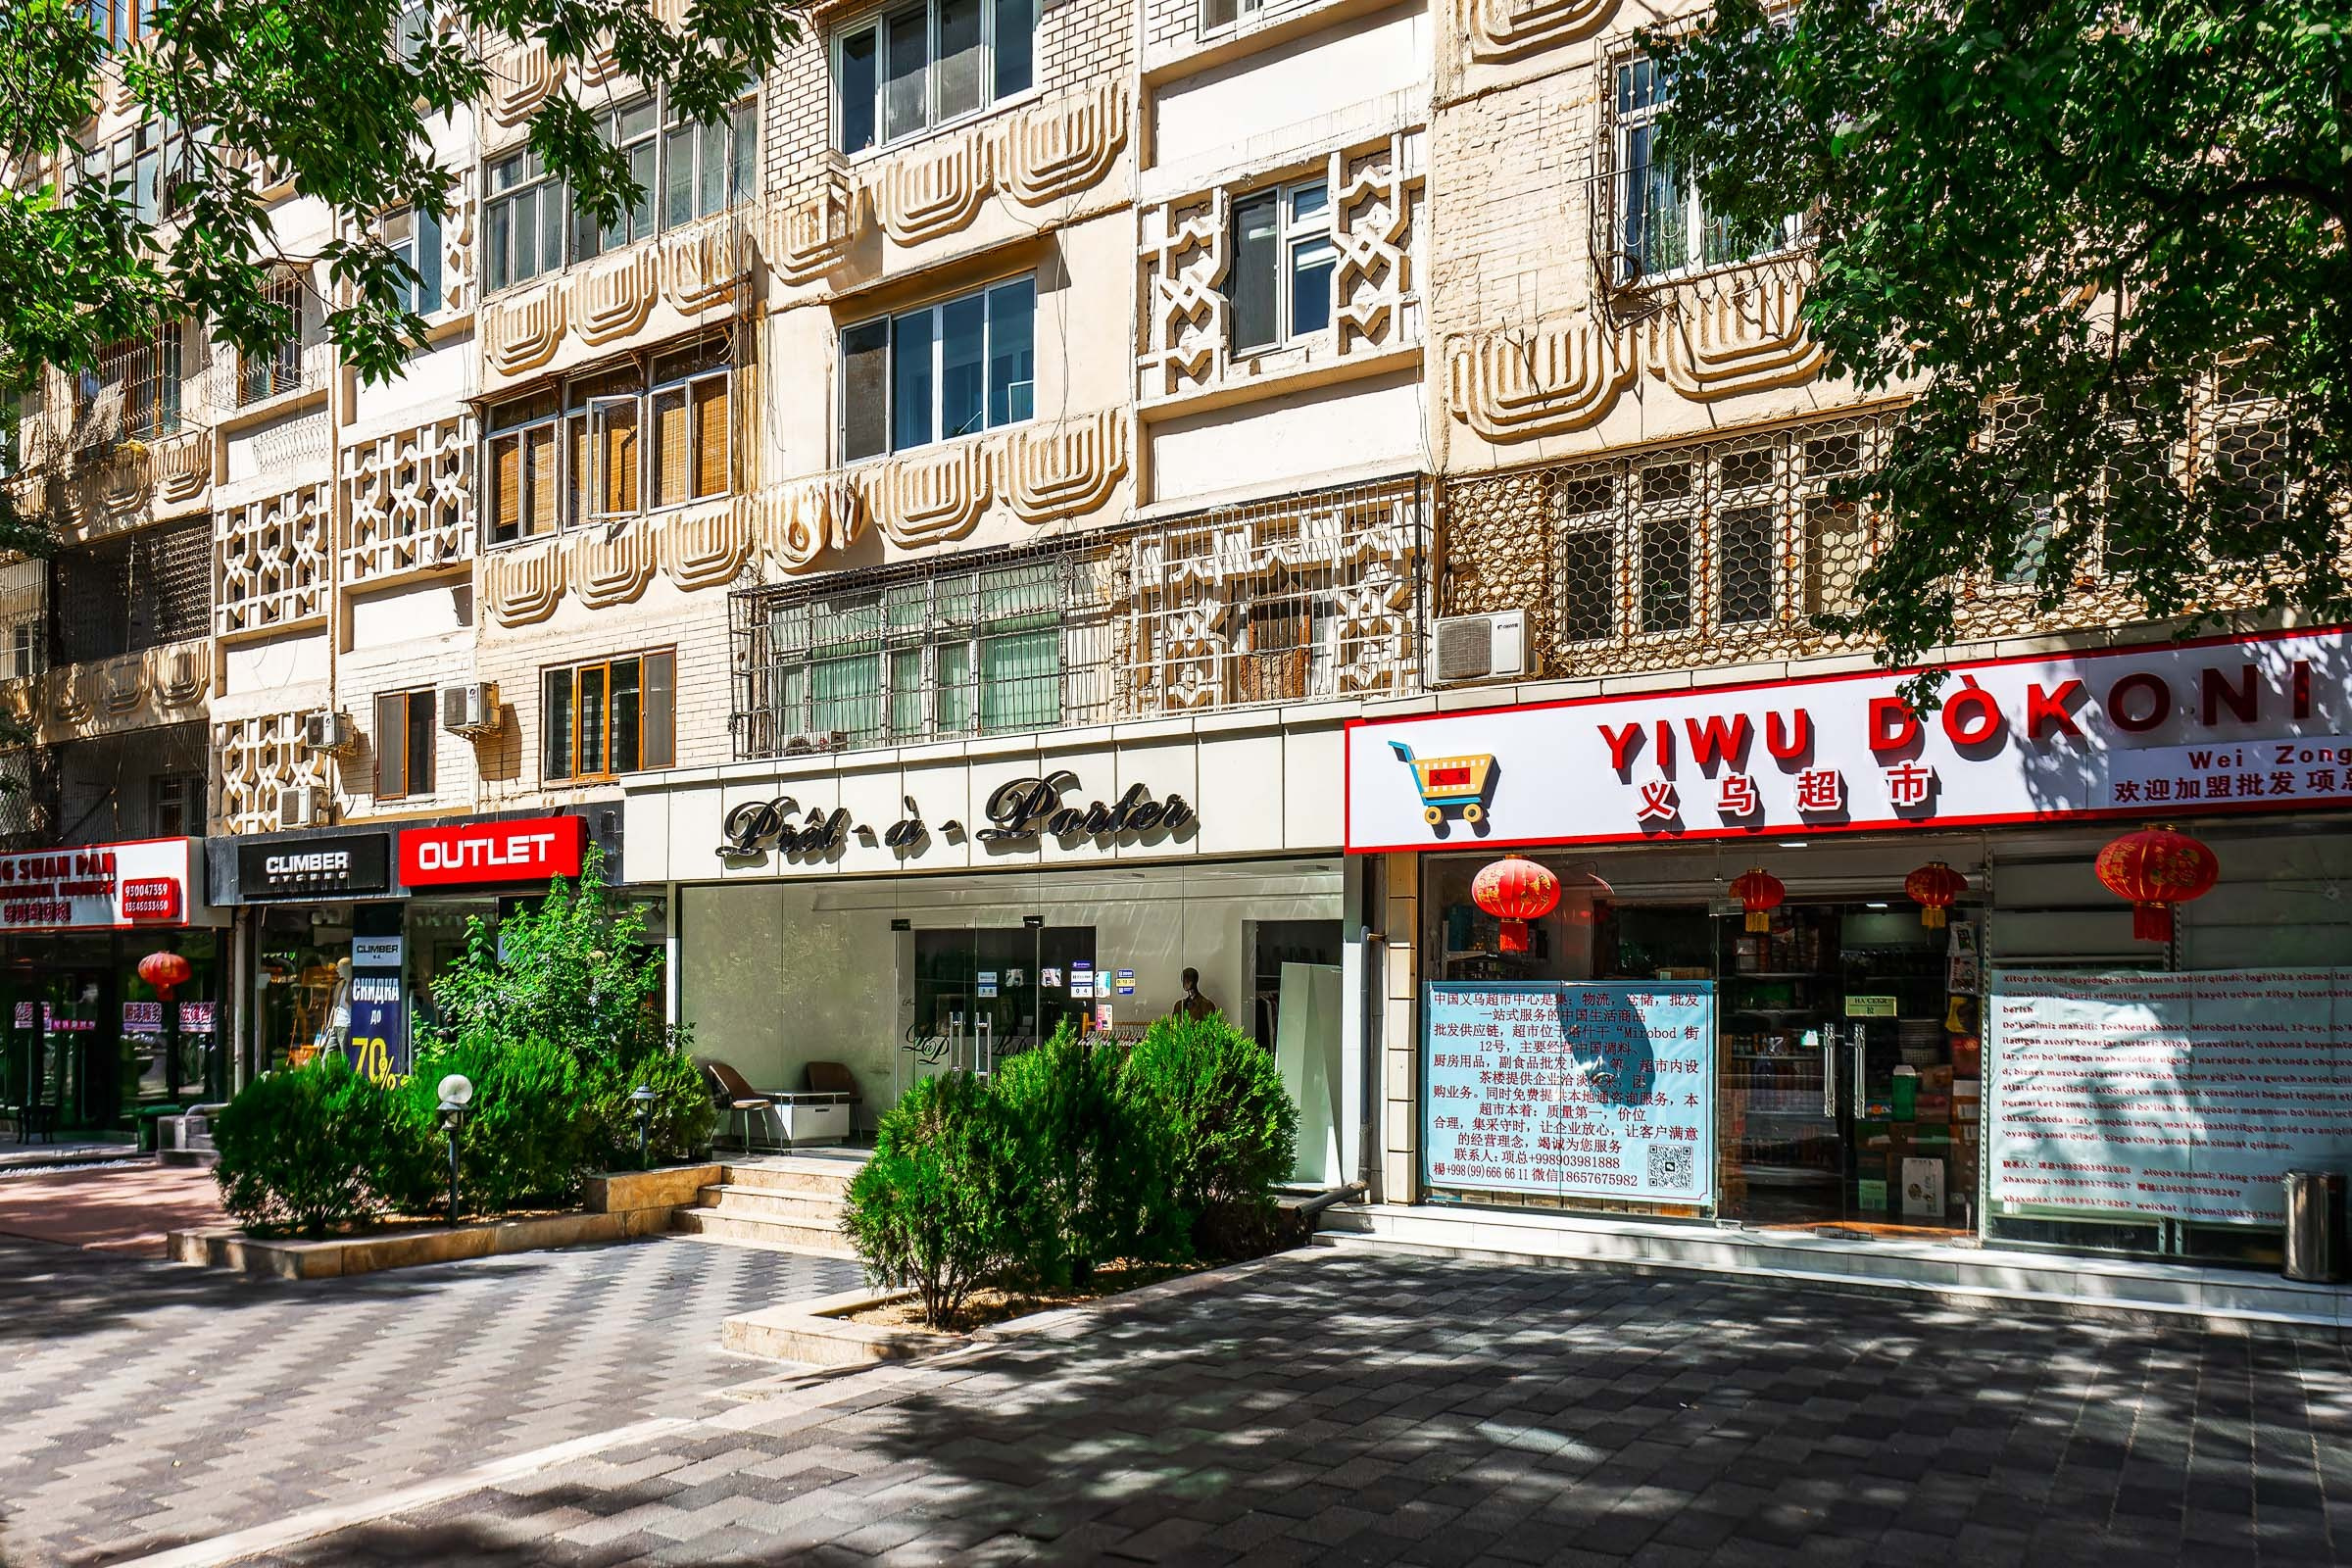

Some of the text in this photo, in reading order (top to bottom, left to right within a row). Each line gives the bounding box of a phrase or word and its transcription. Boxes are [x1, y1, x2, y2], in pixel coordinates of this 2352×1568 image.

[1597, 707, 1809, 769] YIWU
[2188, 749, 2243, 769] Wei
[1637, 760, 1936, 821] 义乌超市
[2114, 770, 2295, 803] 欢迎加盟批发
[266, 852, 349, 874] CLIMBER
[418, 833, 557, 870] OUTLET
[356, 944, 399, 955] CLIMBER
[353, 977, 400, 1004] СКИДКА
[1479, 1008, 1646, 1023] 一站式服务的中国生活商品
[351, 1037, 397, 1091] 70%
